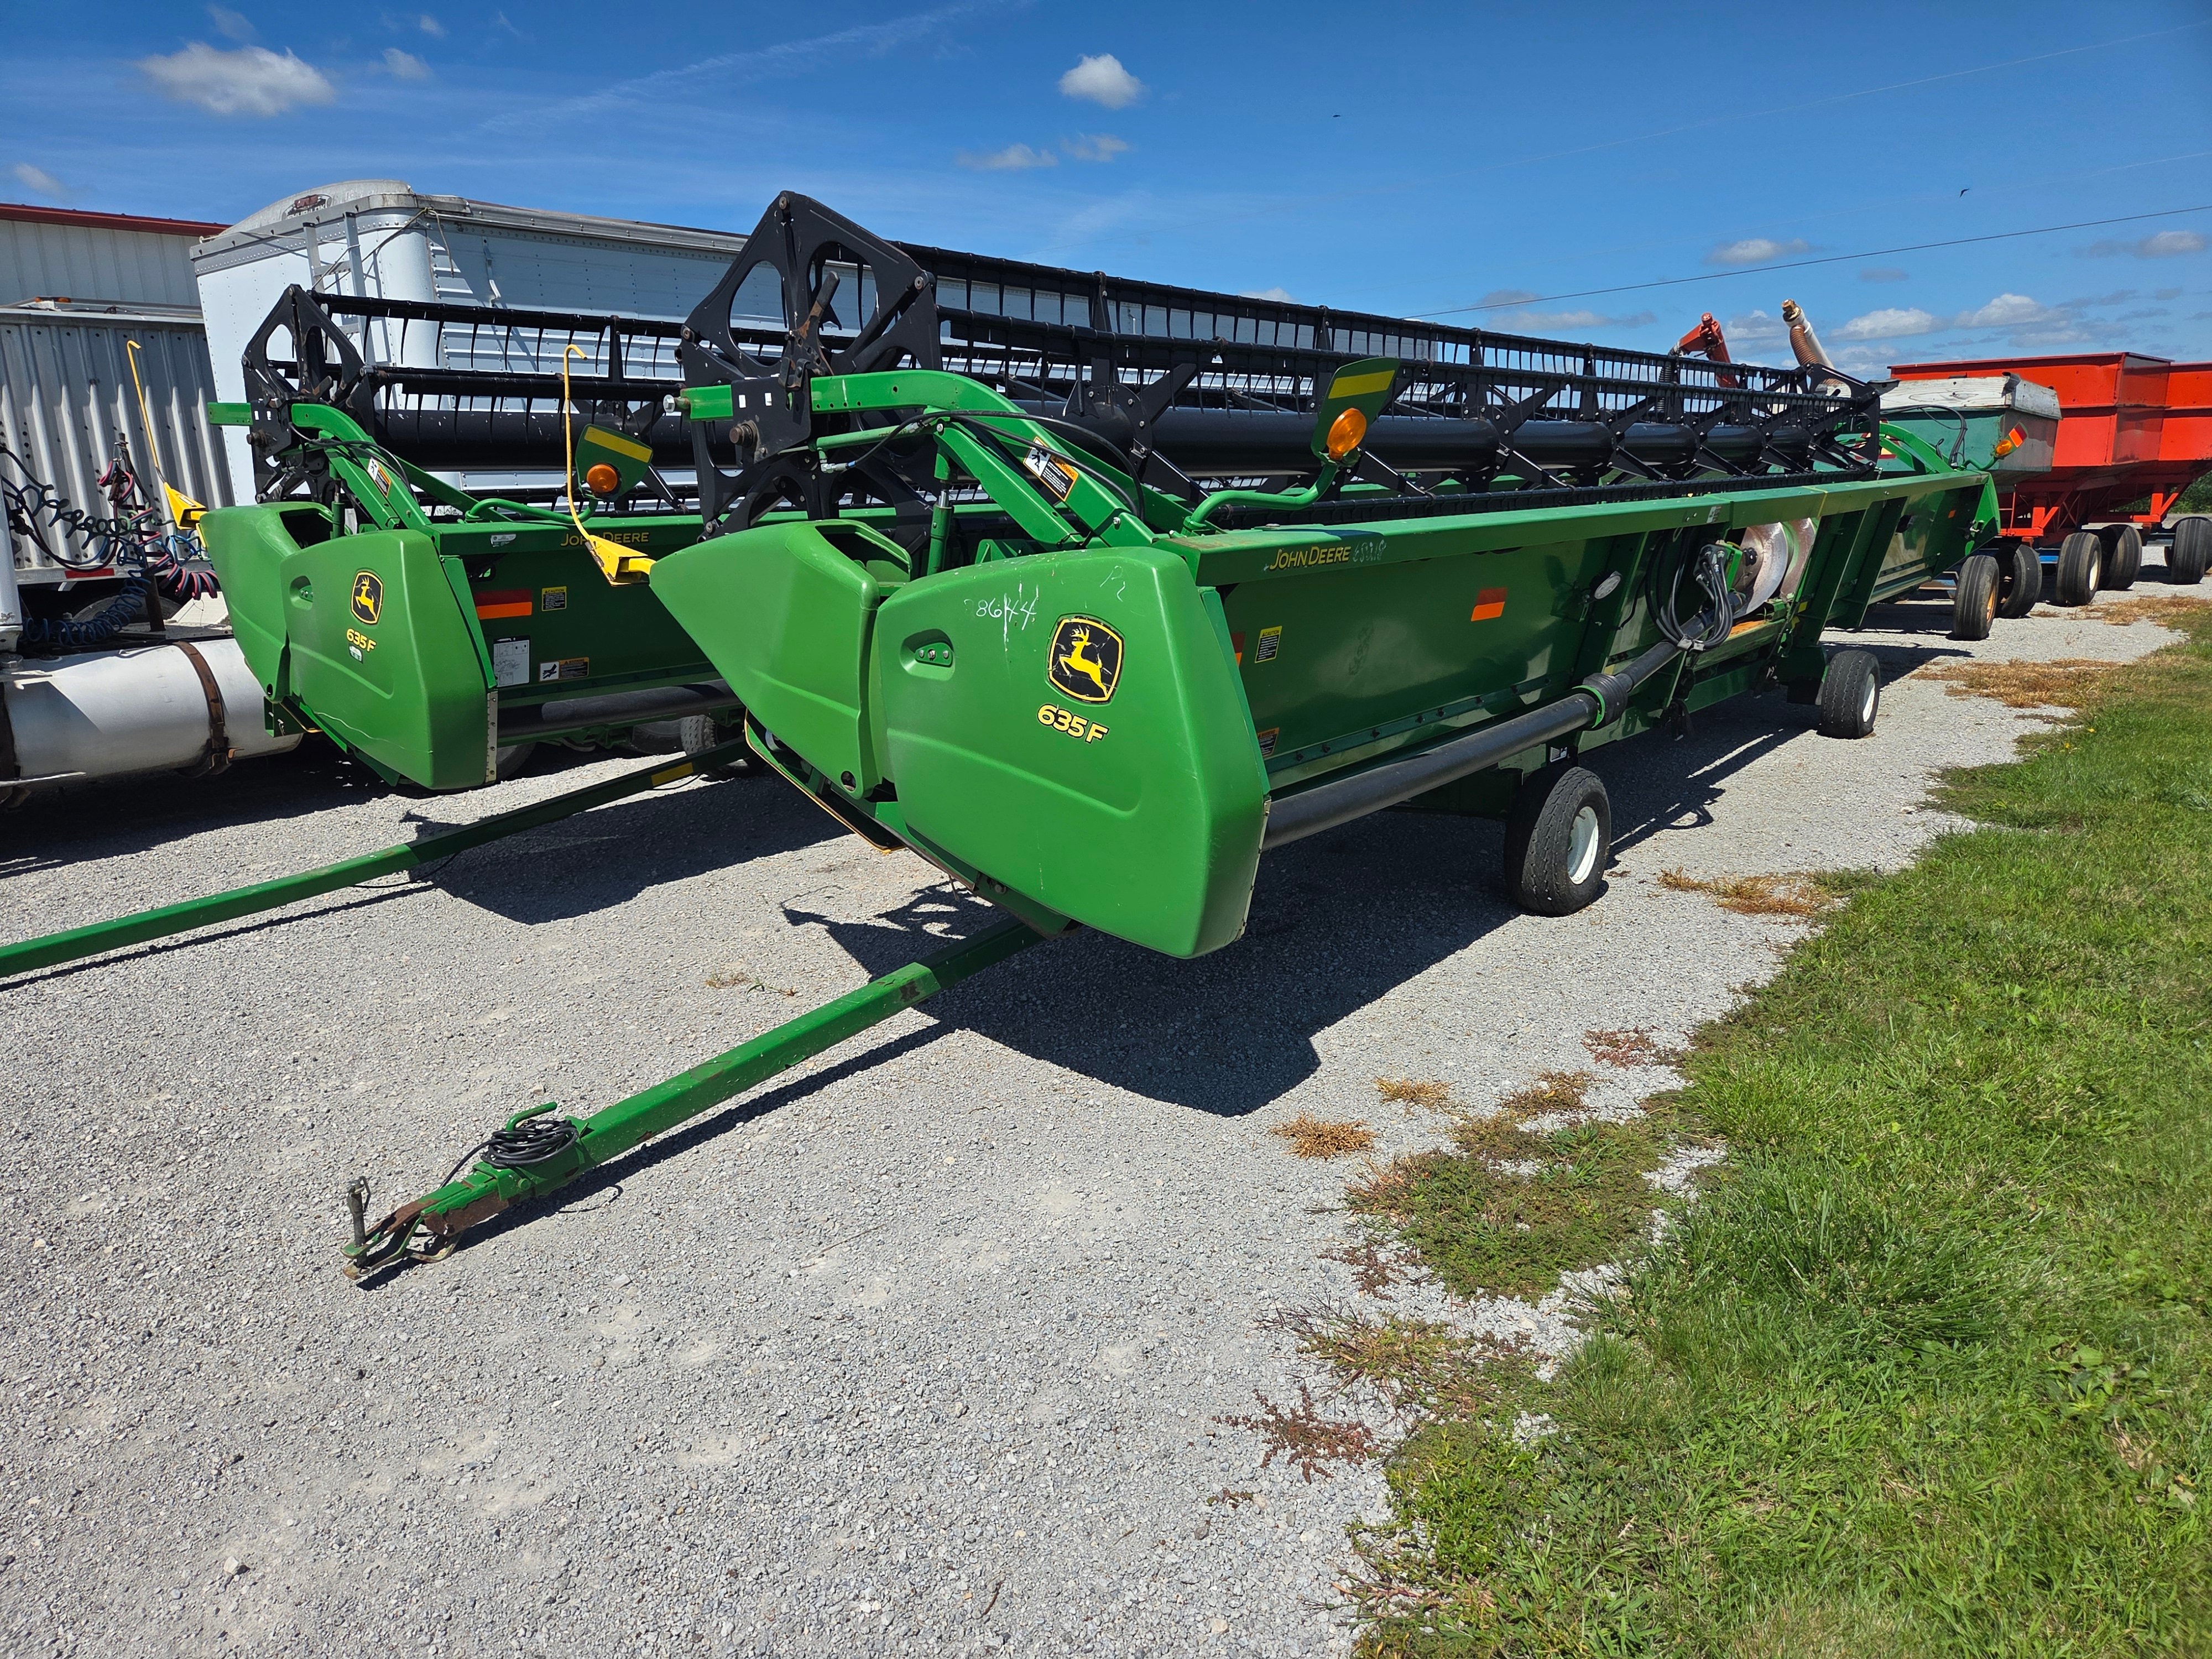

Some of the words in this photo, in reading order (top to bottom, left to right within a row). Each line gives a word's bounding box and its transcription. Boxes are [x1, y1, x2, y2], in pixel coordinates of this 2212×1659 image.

[603, 531, 649, 544] DEERE
[1270, 549, 1308, 570] JOHN
[1308, 546, 1352, 565] DEERE
[346, 628, 377, 652] 635F
[1037, 703, 1109, 743] 635F
